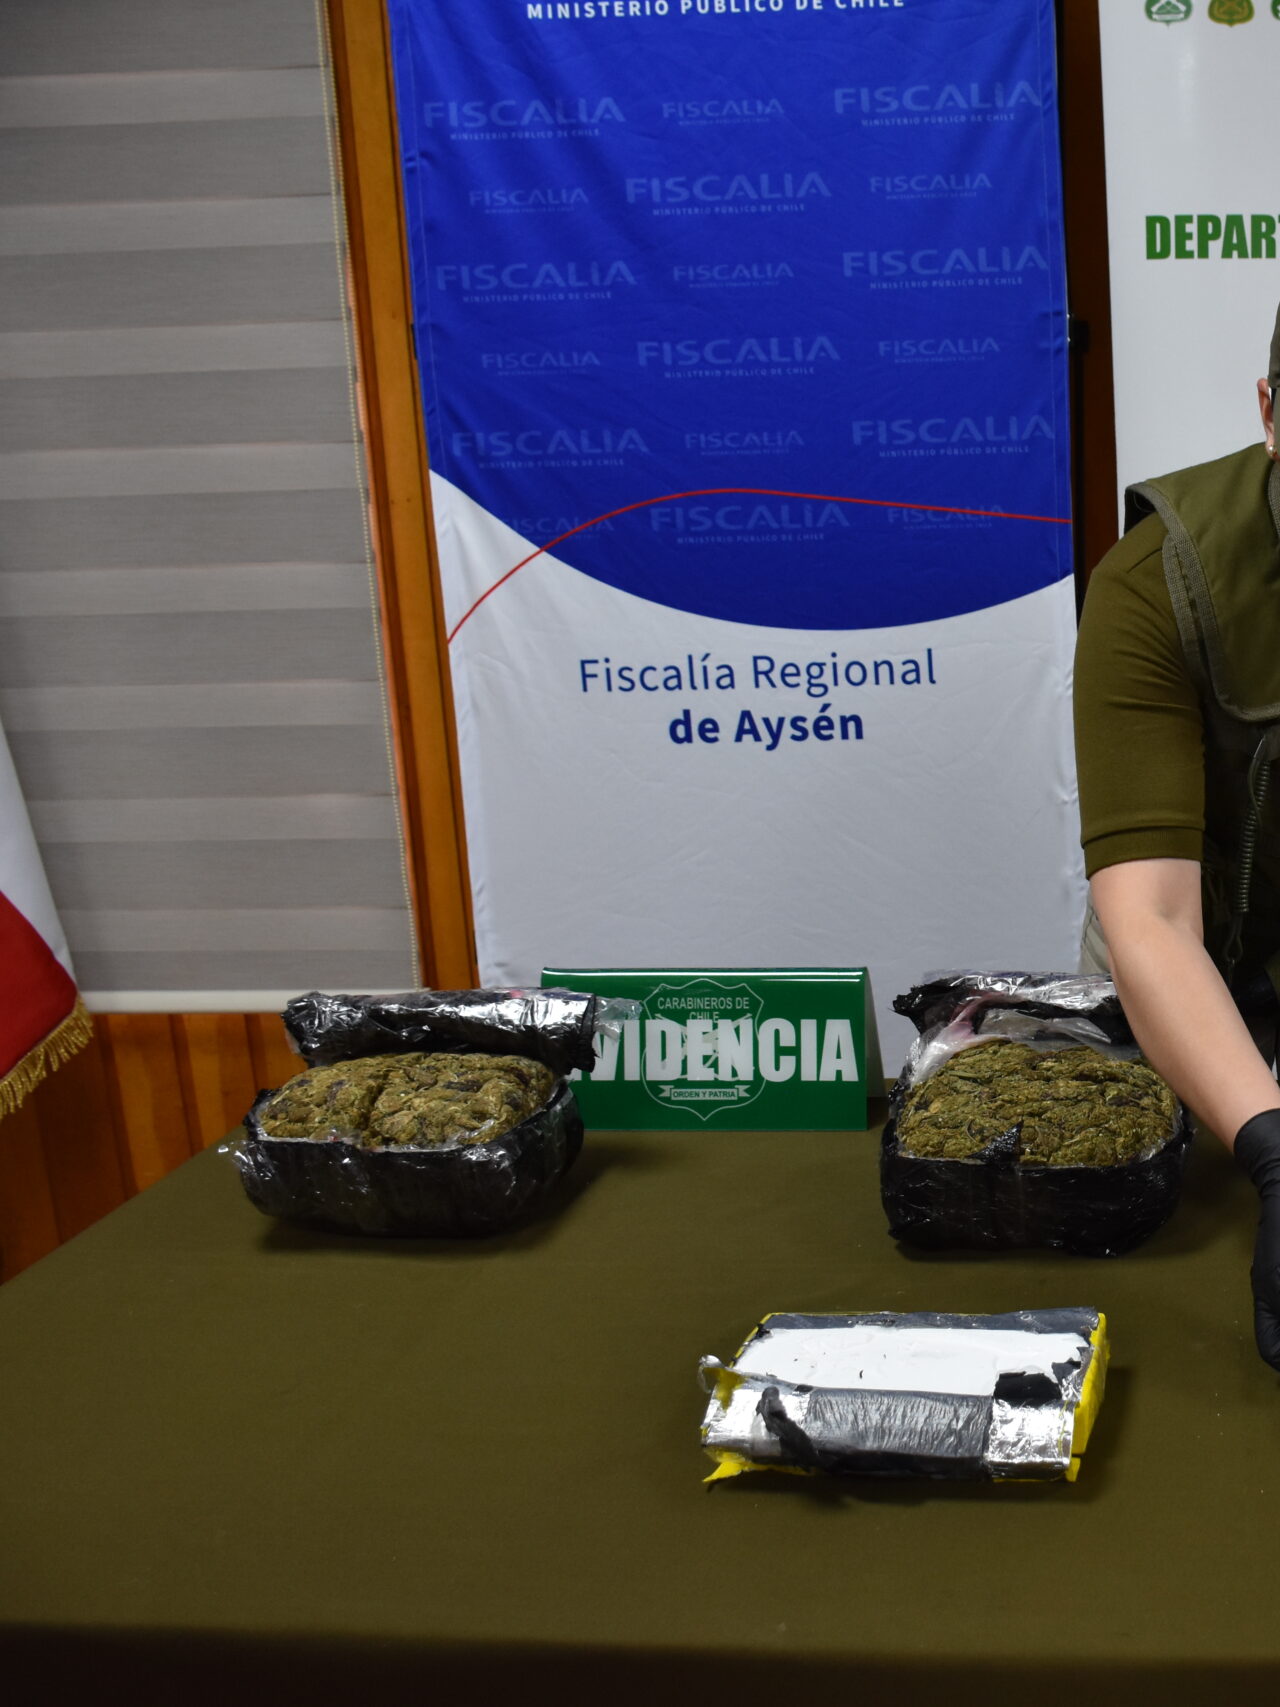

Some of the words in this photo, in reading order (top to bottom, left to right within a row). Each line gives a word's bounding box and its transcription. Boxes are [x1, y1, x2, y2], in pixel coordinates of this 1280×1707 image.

[527, 0, 669, 19] MINISTERIO
[796, 0, 823, 11] DE
[423, 97, 627, 128] FISCALIA
[662, 98, 784, 118] FISCALIA
[834, 80, 1043, 114] FISCALIA
[625, 171, 832, 204] FISCALIA
[869, 172, 992, 193] FISCALIA
[436, 260, 638, 291] FISCALIA
[673, 262, 795, 281] FISCALIA
[842, 245, 1049, 278] FISCALIA
[481, 351, 601, 369] FISCALIA
[636, 335, 841, 367] FISCALIA
[877, 337, 1001, 357] FISCALIA
[452, 428, 653, 456] FISCALIA
[684, 430, 805, 449] FISCALIA
[852, 415, 1056, 446] FISCALIA
[650, 502, 851, 533] FISCALIA
[580, 653, 736, 692] Fiscalía
[752, 648, 936, 698] Regional
[669, 709, 720, 744] de
[734, 703, 864, 751] Aysén
[657, 997, 733, 1009] CARABINEROS
[736, 997, 749, 1009] DE
[564, 1018, 859, 1082] VIDENCIA
[673, 1090, 700, 1098] ORDEN
[700, 1090, 707, 1098] Y
[708, 1090, 736, 1098] PATRIA
